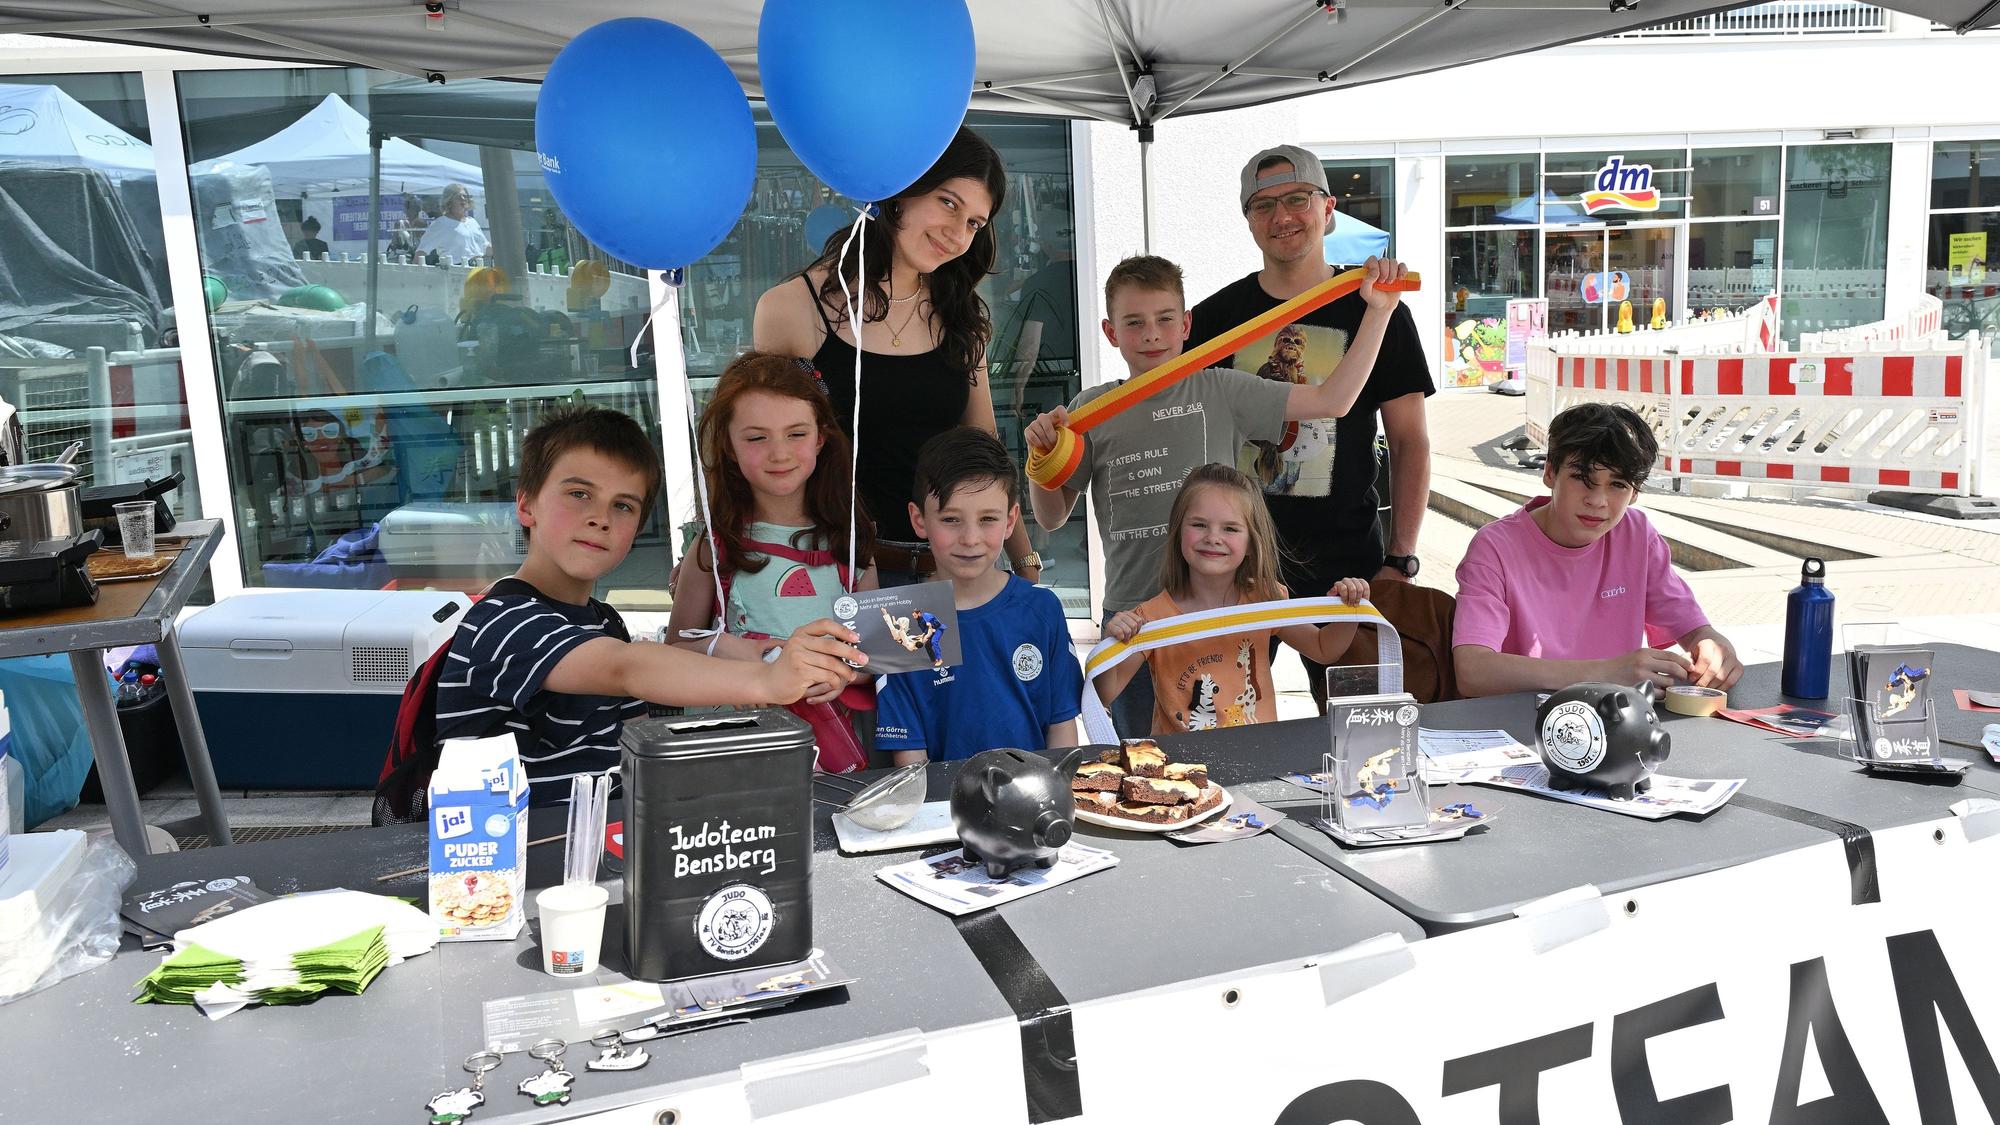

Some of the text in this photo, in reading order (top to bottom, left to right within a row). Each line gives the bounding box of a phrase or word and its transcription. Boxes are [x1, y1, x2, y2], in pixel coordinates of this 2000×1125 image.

[542, 153, 560, 170] Bank
[1598, 158, 1650, 192] dm
[1760, 199, 1770, 210] 51
[1152, 402, 1203, 419] NEVER 2L8
[1106, 448, 1169, 468] SKATERS RULE
[1128, 466, 1162, 481] & OWN
[1124, 479, 1183, 499] THE STREETS
[1110, 527, 1168, 542] WIN THE GA
[1558, 705, 1585, 715] JUDO
[885, 725, 908, 734] Görres
[1577, 755, 1593, 767] 1901
[442, 811, 466, 834] ja!
[669, 820, 776, 851] Judoteam
[444, 841, 498, 858] PUDER
[449, 856, 494, 868] ZUCKER
[674, 844, 776, 878] Bensberg
[722, 890, 746, 903] JUDO
